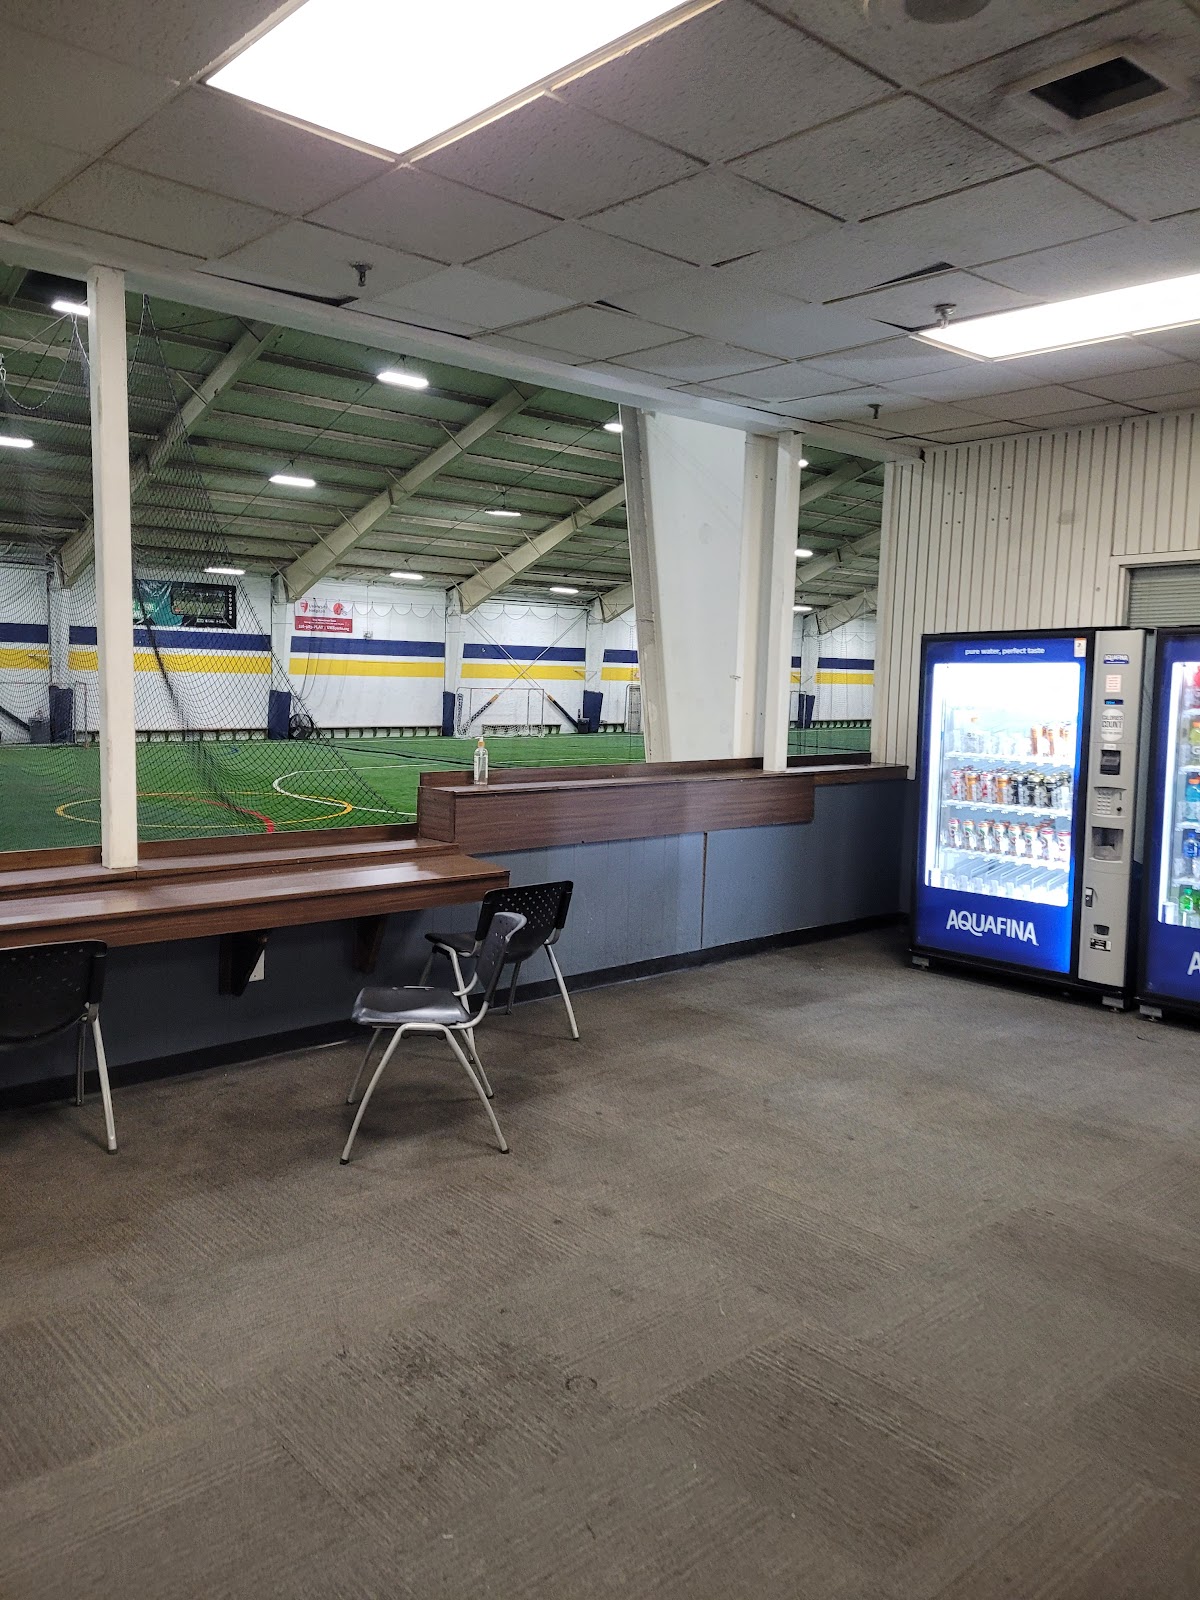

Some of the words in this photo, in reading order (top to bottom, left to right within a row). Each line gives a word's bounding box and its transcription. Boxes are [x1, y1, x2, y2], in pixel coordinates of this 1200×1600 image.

[981, 648, 1002, 656] water,
[1002, 647, 1027, 656] perfect
[946, 909, 1039, 946] AQUAFINA
